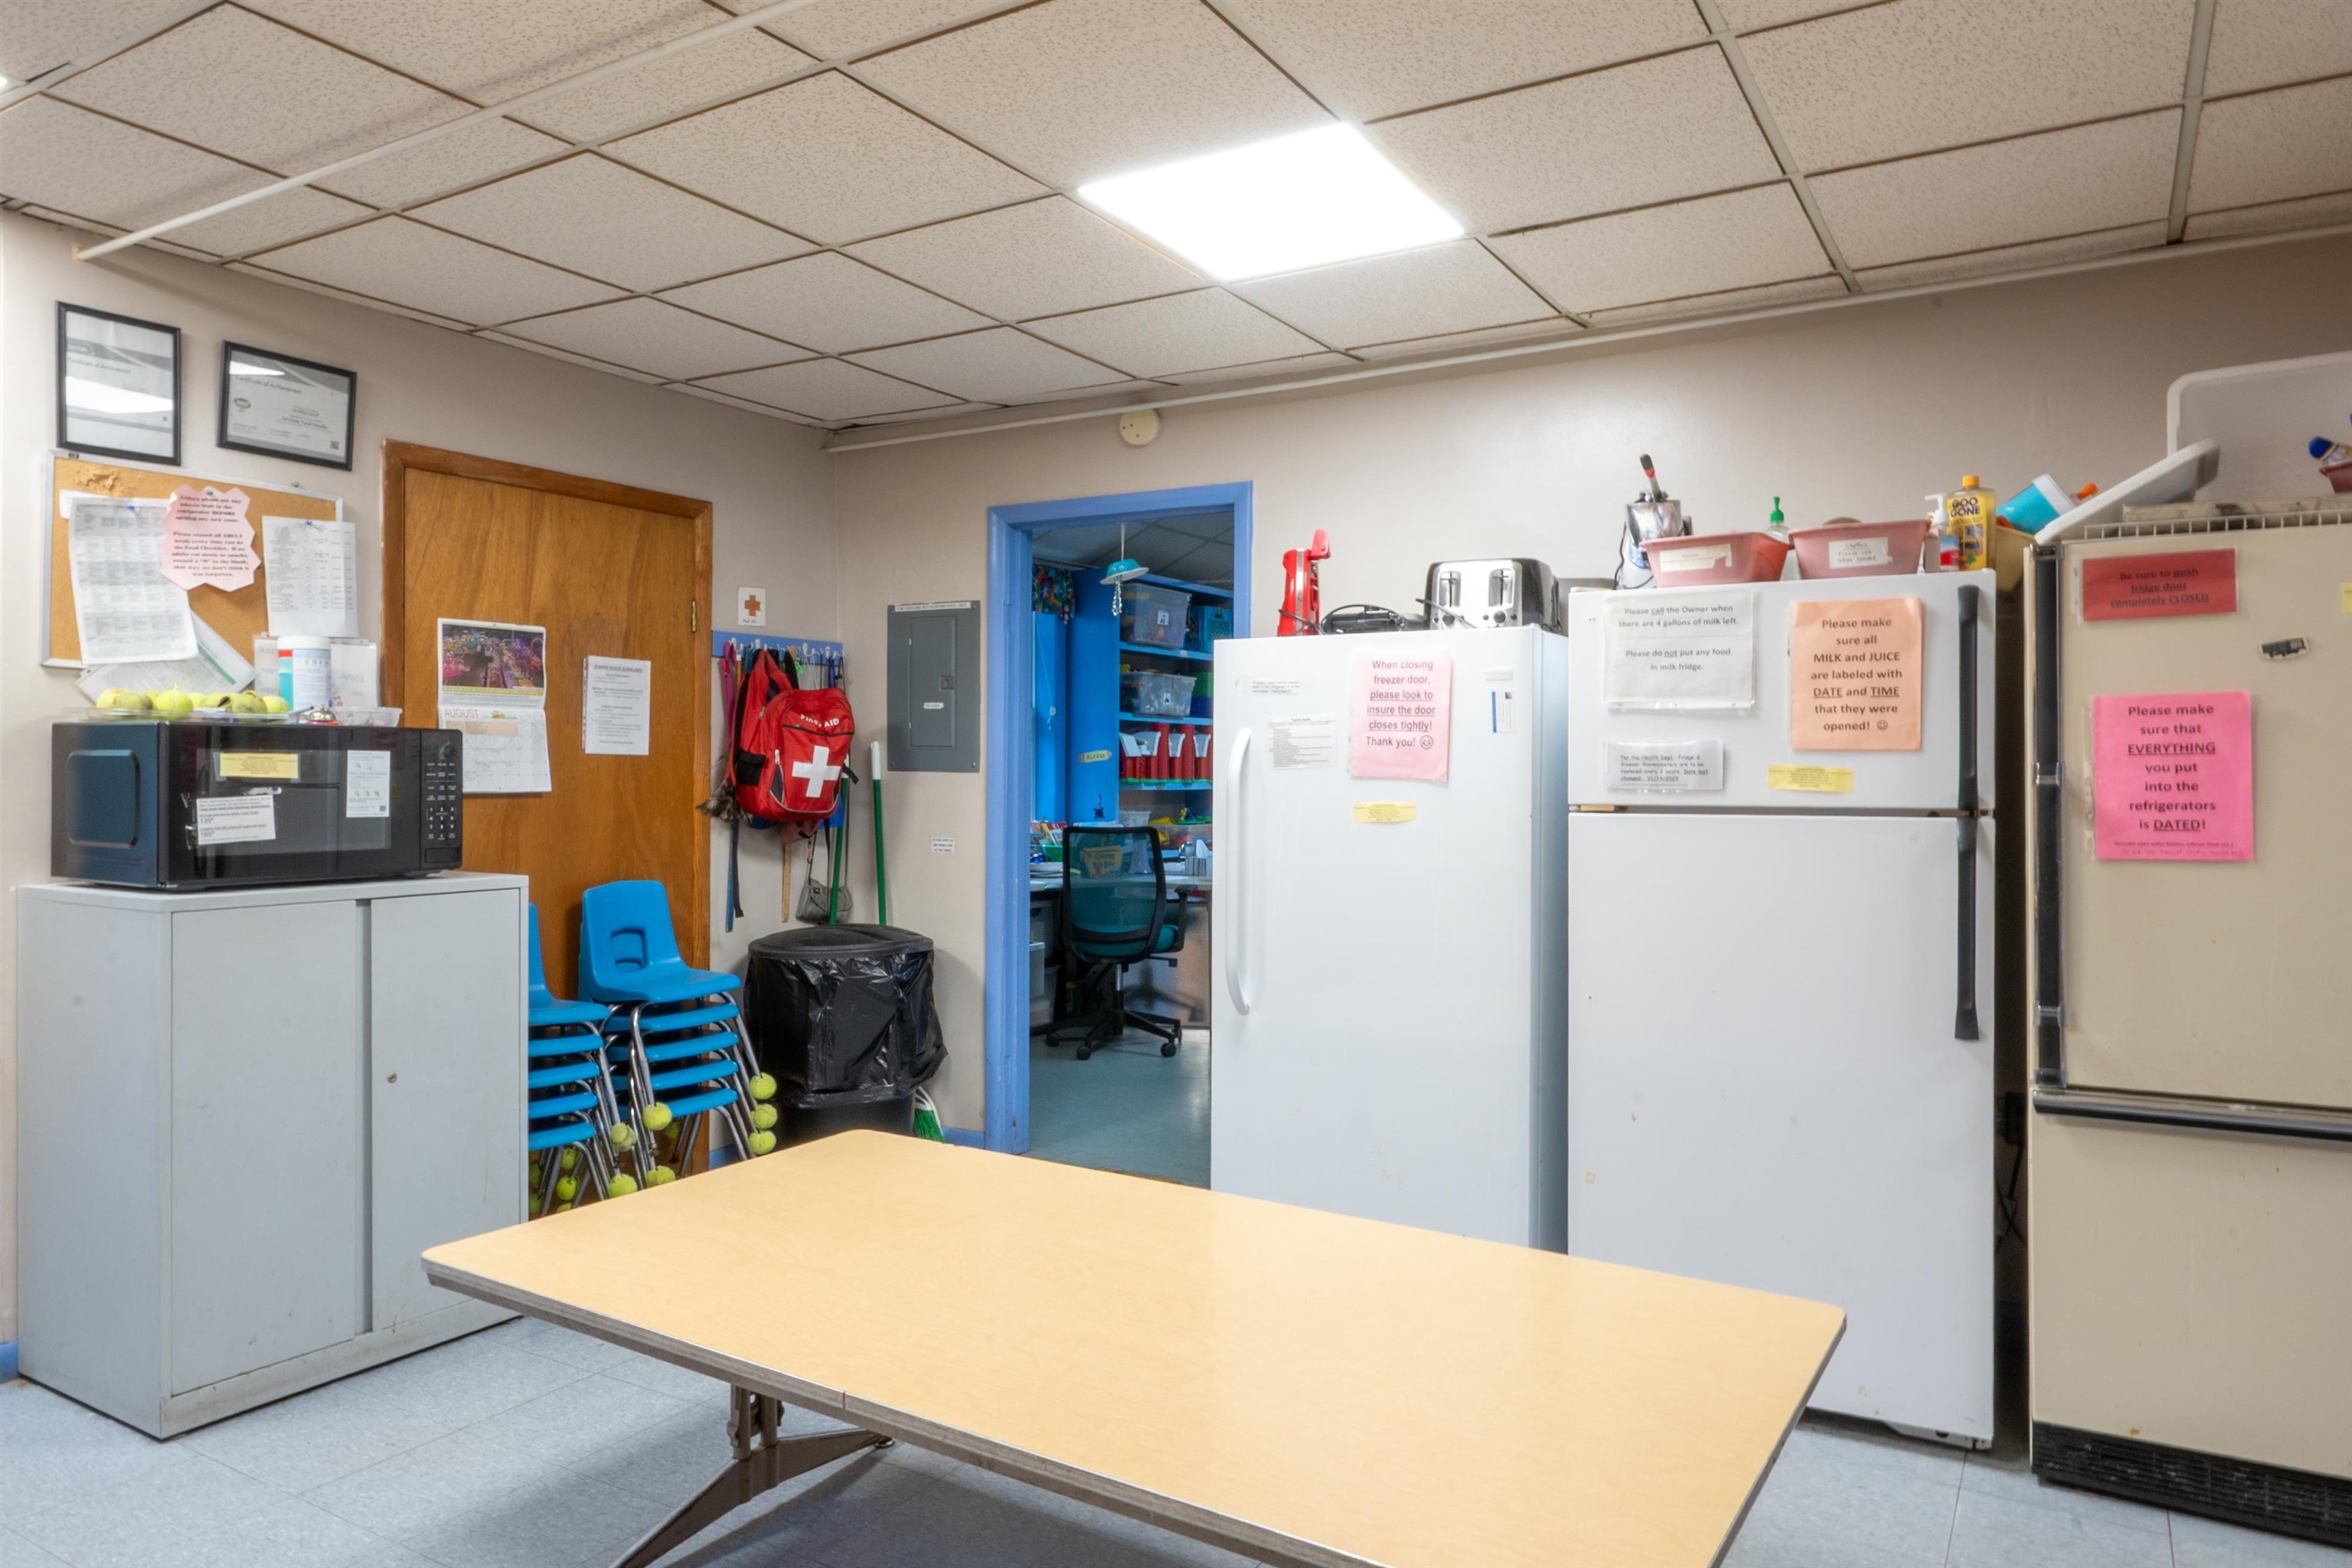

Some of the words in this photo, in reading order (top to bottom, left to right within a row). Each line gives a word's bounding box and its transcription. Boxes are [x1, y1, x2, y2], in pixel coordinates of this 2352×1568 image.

[1952, 497, 1978, 508] GOO
[1951, 506, 1979, 517] GONE
[2174, 568, 2198, 577] push
[2132, 584, 2160, 593] fridge
[2163, 583, 2187, 591] door
[2110, 597, 2166, 608] completely
[2168, 593, 2209, 603] CLOSED
[1663, 619, 1690, 628] gallons
[1822, 619, 1857, 628] Please
[1861, 618, 1892, 627] make
[1864, 635, 1877, 644] all
[1814, 653, 1841, 662] MILK
[1845, 652, 1865, 662] and
[1869, 652, 1900, 662] JUICE
[1372, 660, 1397, 669] When
[1401, 661, 1433, 671] closing
[1679, 663, 1704, 671] fridge.
[1374, 675, 1404, 684] freezer
[1832, 670, 1873, 679] labeled
[1877, 669, 1902, 678] with
[1370, 690, 1400, 701] please
[1403, 690, 1421, 699] look
[1424, 691, 1433, 699] to
[1814, 688, 1842, 698] DATE
[1846, 687, 1867, 696] and
[1870, 687, 1900, 697] TIME
[444, 709, 478, 717] AUGUST
[1367, 705, 1395, 714] insure
[1398, 705, 1412, 714] the
[1415, 705, 1436, 714] door
[1815, 705, 1837, 714] that
[1841, 704, 1865, 714] they
[2128, 706, 2171, 716] Please
[2176, 704, 2213, 714] make
[825, 718, 839, 727] AID
[1369, 720, 1398, 729] closes
[1401, 720, 1432, 732] tightly!
[1824, 721, 1870, 732] opened!
[2174, 724, 2201, 733] that
[1366, 737, 1393, 746] Thank
[1396, 737, 1416, 749] you!
[2128, 743, 2216, 756] EVERYTHING
[2145, 765, 2170, 774] you
[2175, 763, 2197, 773] put
[2145, 781, 2171, 792] into
[2177, 781, 2199, 791] the
[2129, 801, 2215, 812] refrigerators
[2139, 819, 2149, 829] is
[2154, 819, 2206, 831] DATED!
